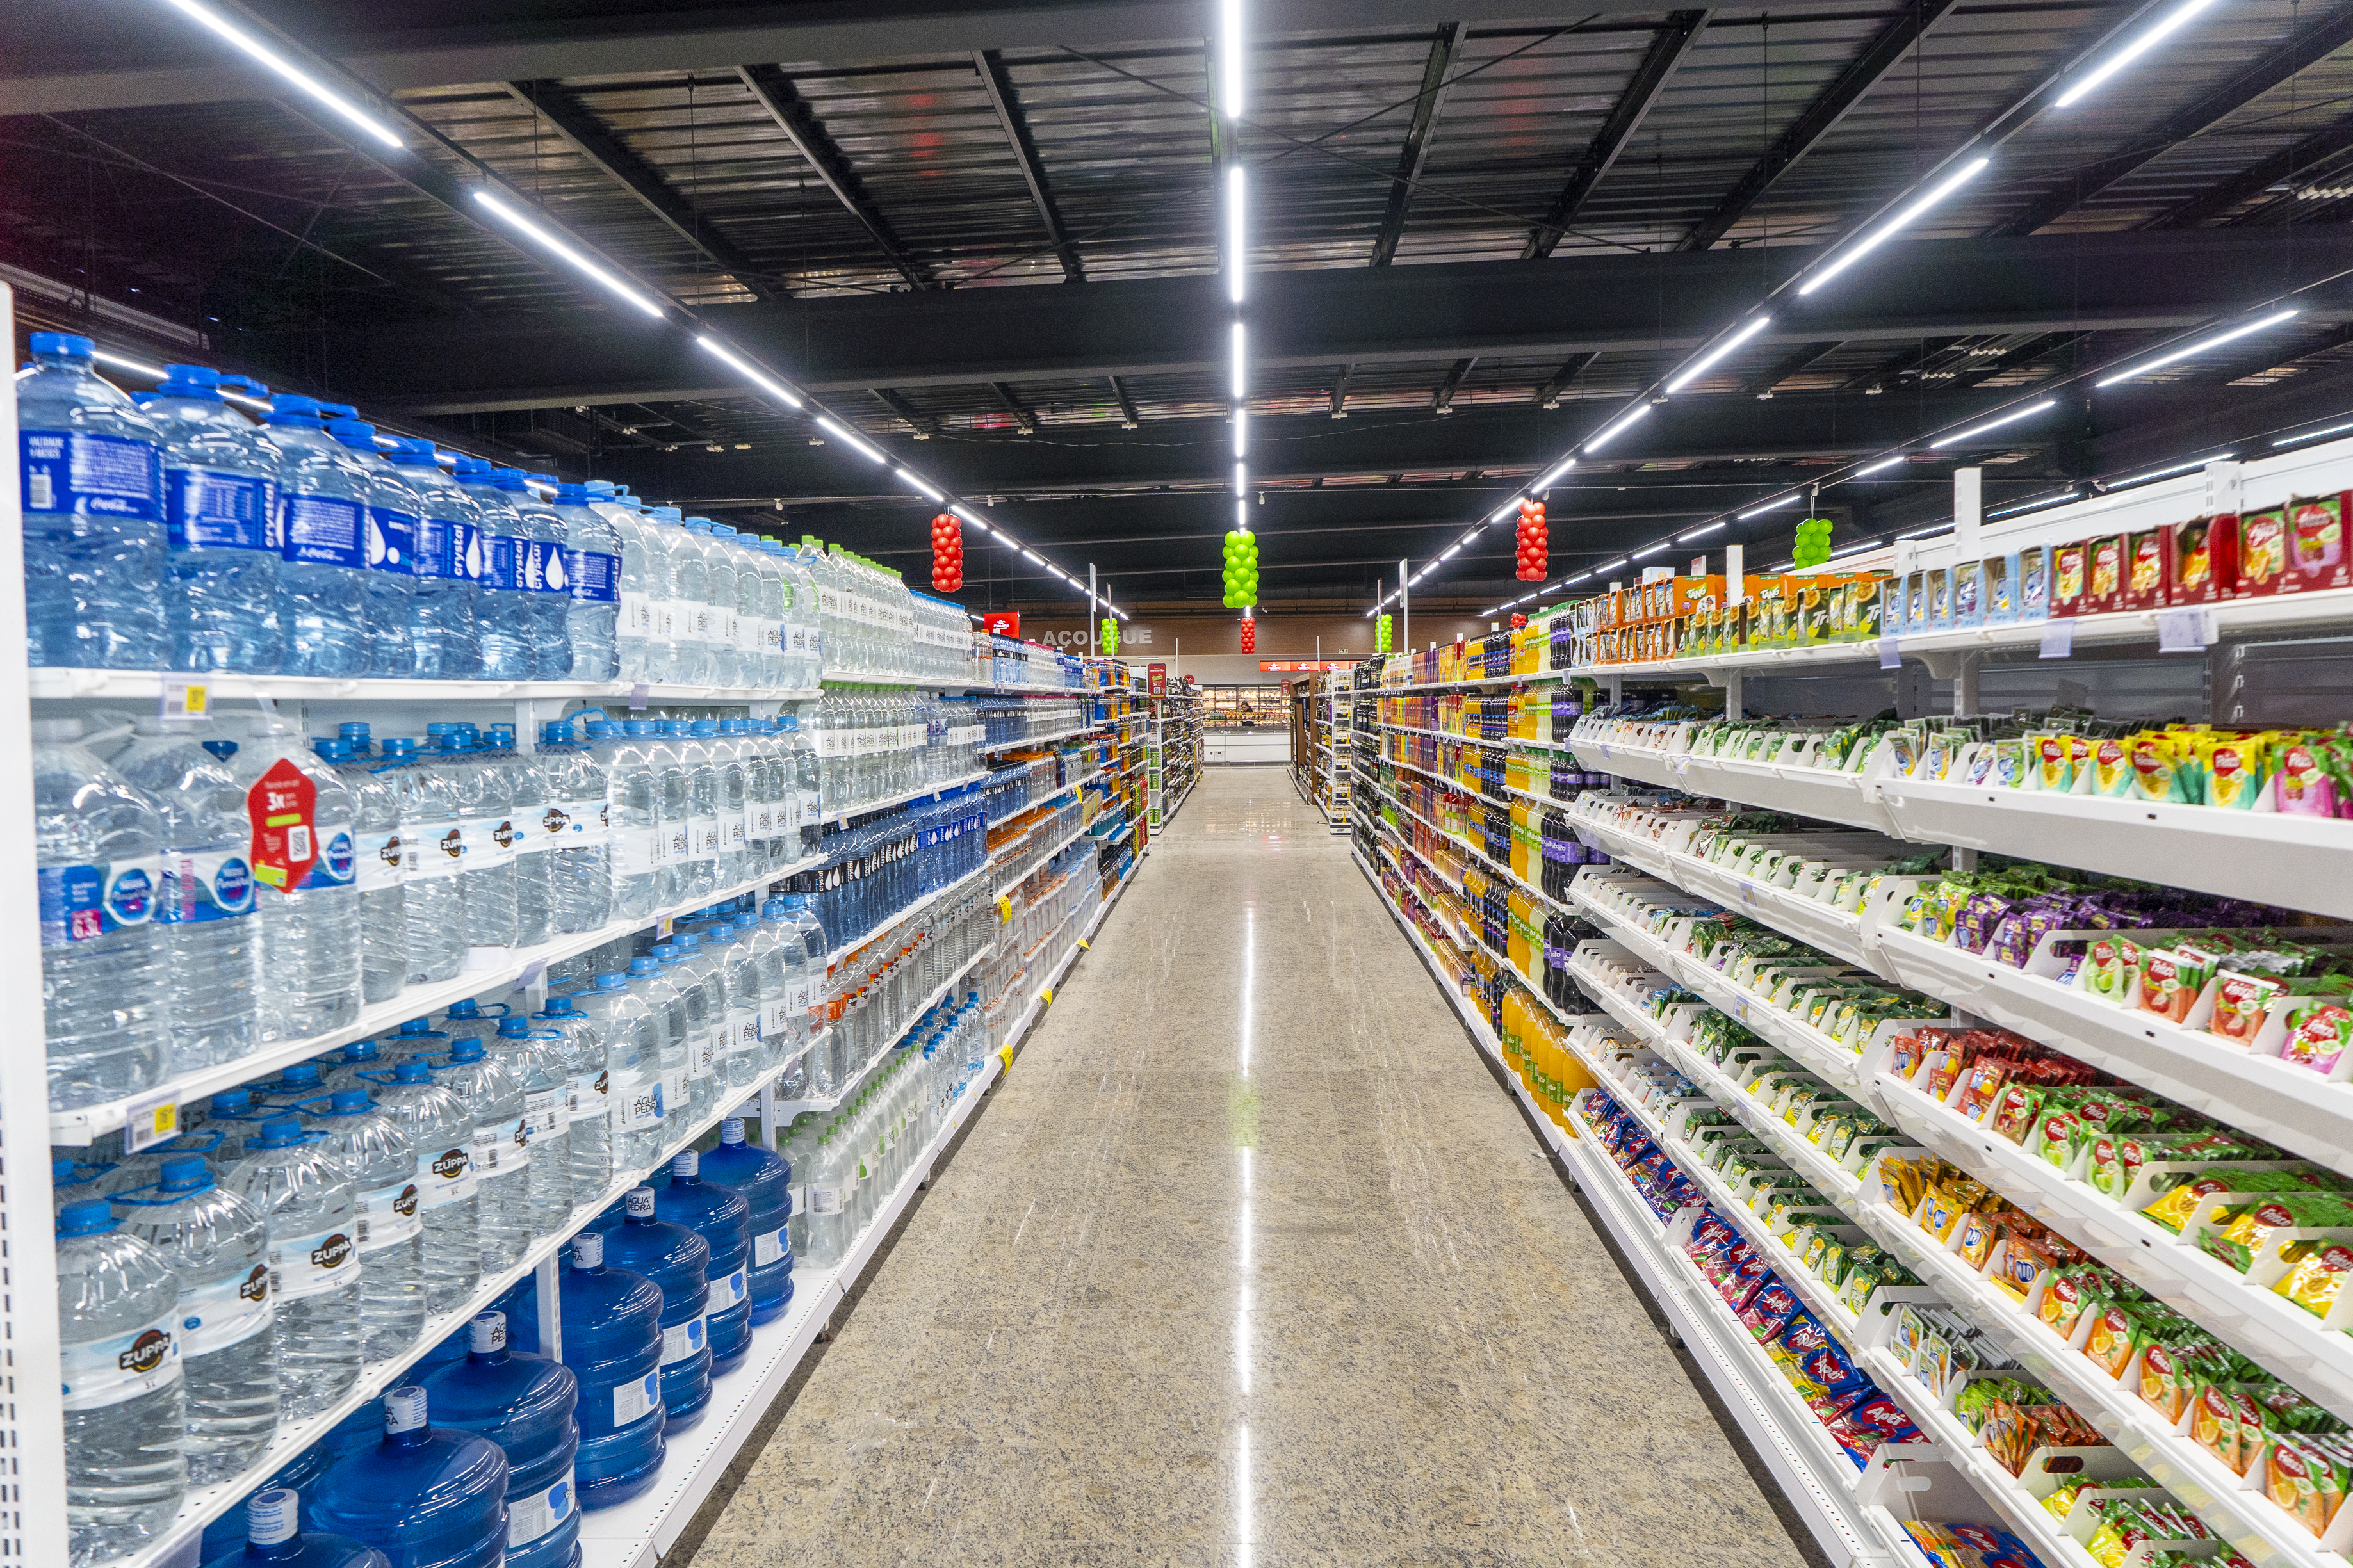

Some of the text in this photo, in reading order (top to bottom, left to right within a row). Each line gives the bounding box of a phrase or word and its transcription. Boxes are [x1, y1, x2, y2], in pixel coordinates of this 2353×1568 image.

[265, 483, 275, 548] crystal
[453, 524, 464, 576] crystal
[514, 540, 525, 588] crystal
[1686, 586, 1706, 600] TANG
[1759, 586, 1780, 600] TANG
[634, 1095, 657, 1107] ÁGUA
[635, 1103, 660, 1115] PEDRA
[433, 1156, 468, 1174] ZUPPA
[628, 1195, 648, 1204] ÁGUA
[628, 1202, 652, 1211] PEDRA
[312, 1240, 352, 1265] ZUPPA
[2016, 1261, 2035, 1281] MID
[2056, 1281, 2077, 1302] Frisco
[120, 1337, 170, 1369] ZUPPA
[2149, 1349, 2171, 1373] Frisco
[1814, 1358, 1842, 1380] Apti
[1866, 1407, 1903, 1427] Apti
